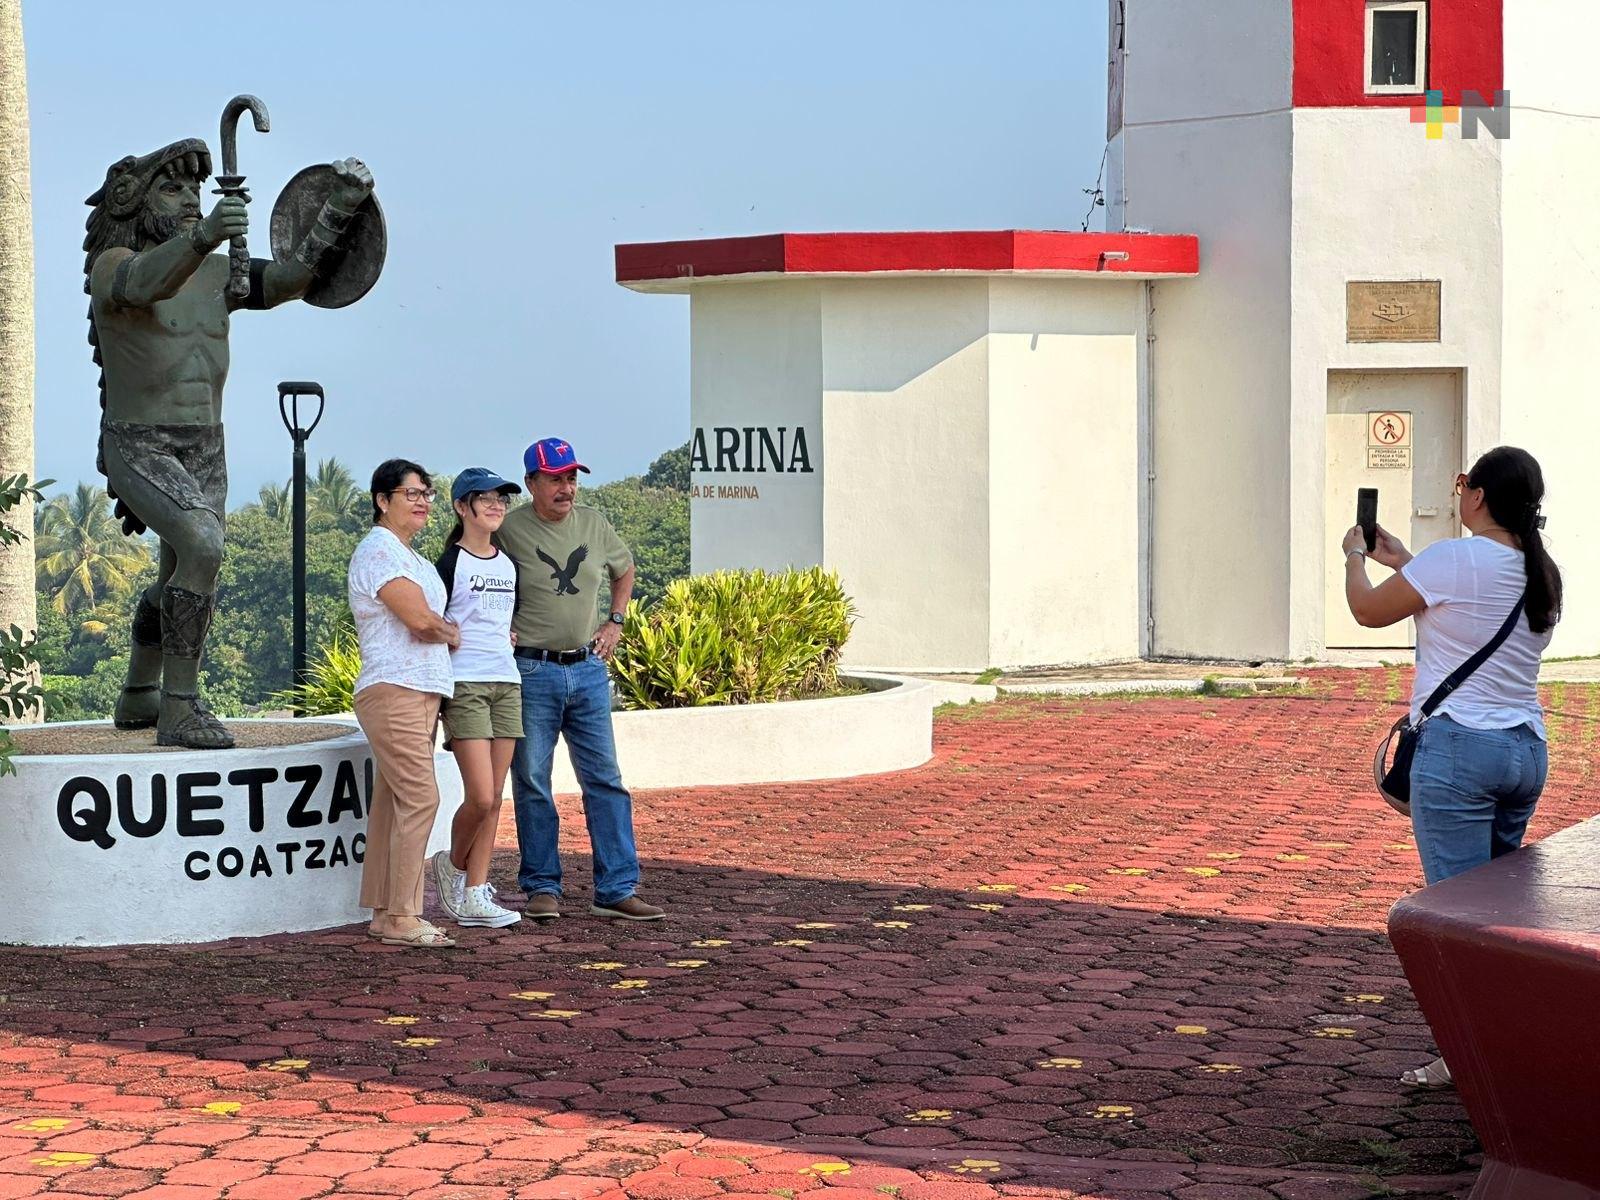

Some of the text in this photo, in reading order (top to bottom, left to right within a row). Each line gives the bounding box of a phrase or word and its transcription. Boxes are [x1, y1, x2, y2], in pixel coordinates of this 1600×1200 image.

[690, 427, 814, 472] ARINA
[703, 486, 714, 498] DE
[718, 486, 759, 499] MARINA
[470, 574, 515, 593] Denver
[184, 832, 367, 881] COATZAC
